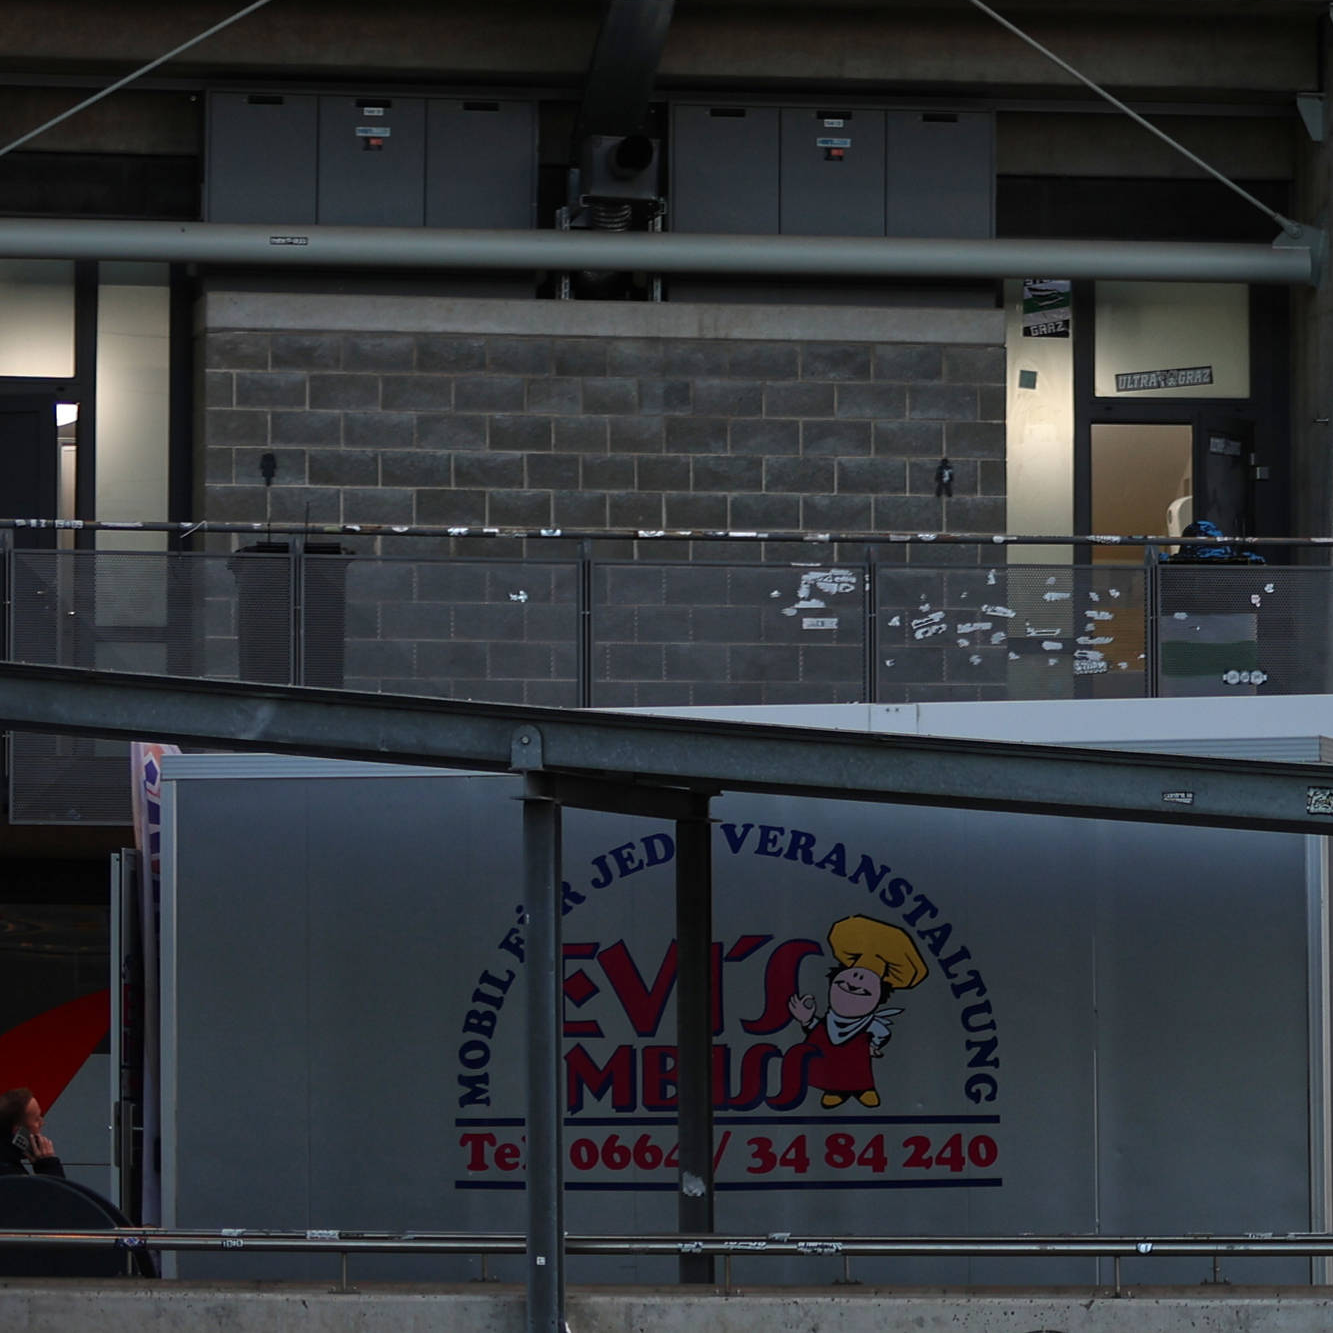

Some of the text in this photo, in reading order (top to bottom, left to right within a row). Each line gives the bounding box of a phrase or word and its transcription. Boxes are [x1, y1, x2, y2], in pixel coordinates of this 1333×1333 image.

[1029, 321, 1066, 337] GRAZ
[1117, 367, 1211, 391] ULTRA GRAZ
[458, 970, 516, 1108] MOBIL
[591, 832, 676, 889] JED
[720, 822, 1000, 1105] VERANSTALTUNG
[563, 1043, 824, 1115] MBISS
[746, 1134, 810, 1174] 34
[825, 1133, 888, 1173] 84
[903, 1134, 999, 1173] 240
